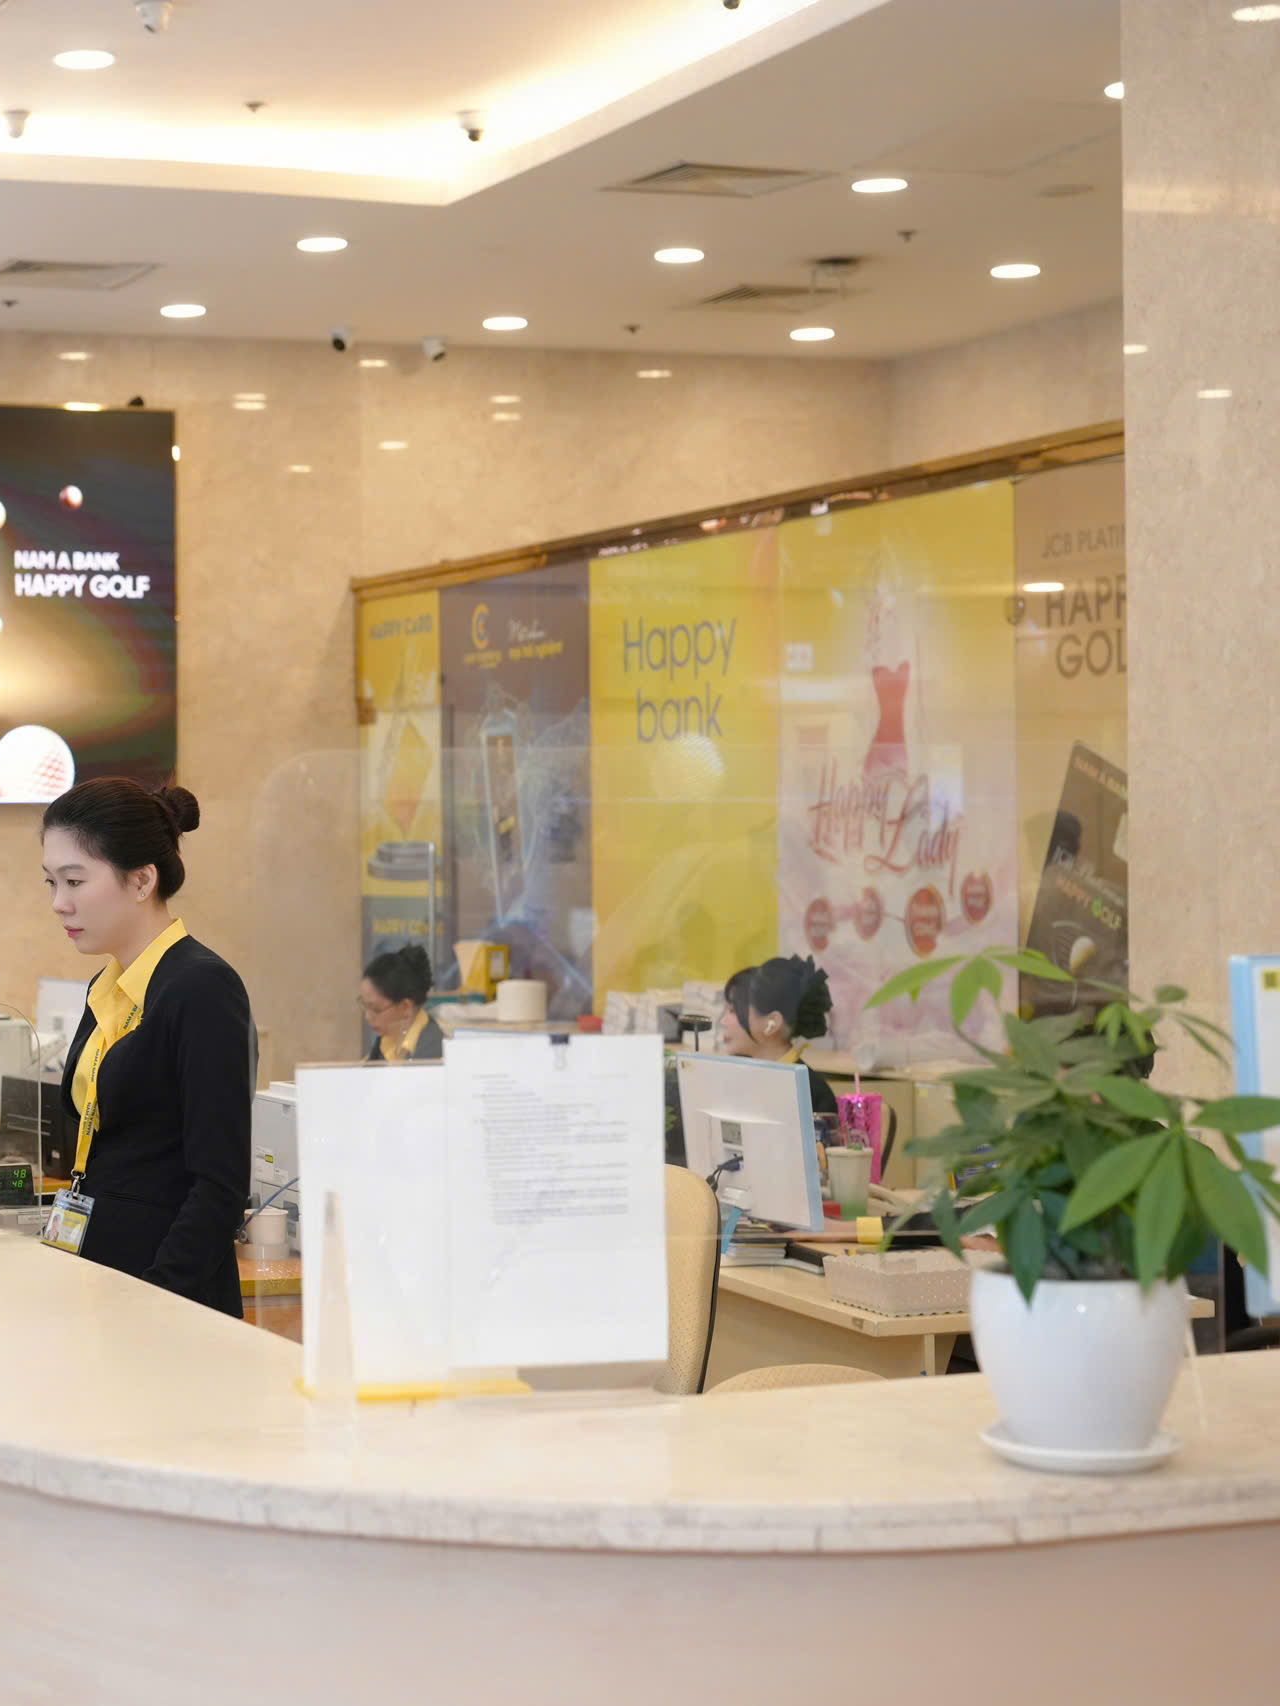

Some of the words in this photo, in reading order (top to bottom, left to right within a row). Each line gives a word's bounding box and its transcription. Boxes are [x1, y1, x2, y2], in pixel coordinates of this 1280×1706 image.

[14, 550, 56, 570] NAM
[56, 551, 72, 570] A
[72, 551, 120, 572] BANK
[14, 573, 87, 598] HAPPY
[89, 574, 151, 599] GOLF
[622, 616, 737, 682] Happy
[636, 682, 723, 743] bank
[12, 1179, 23, 1188] 48
[13, 1168, 27, 1178] 48
